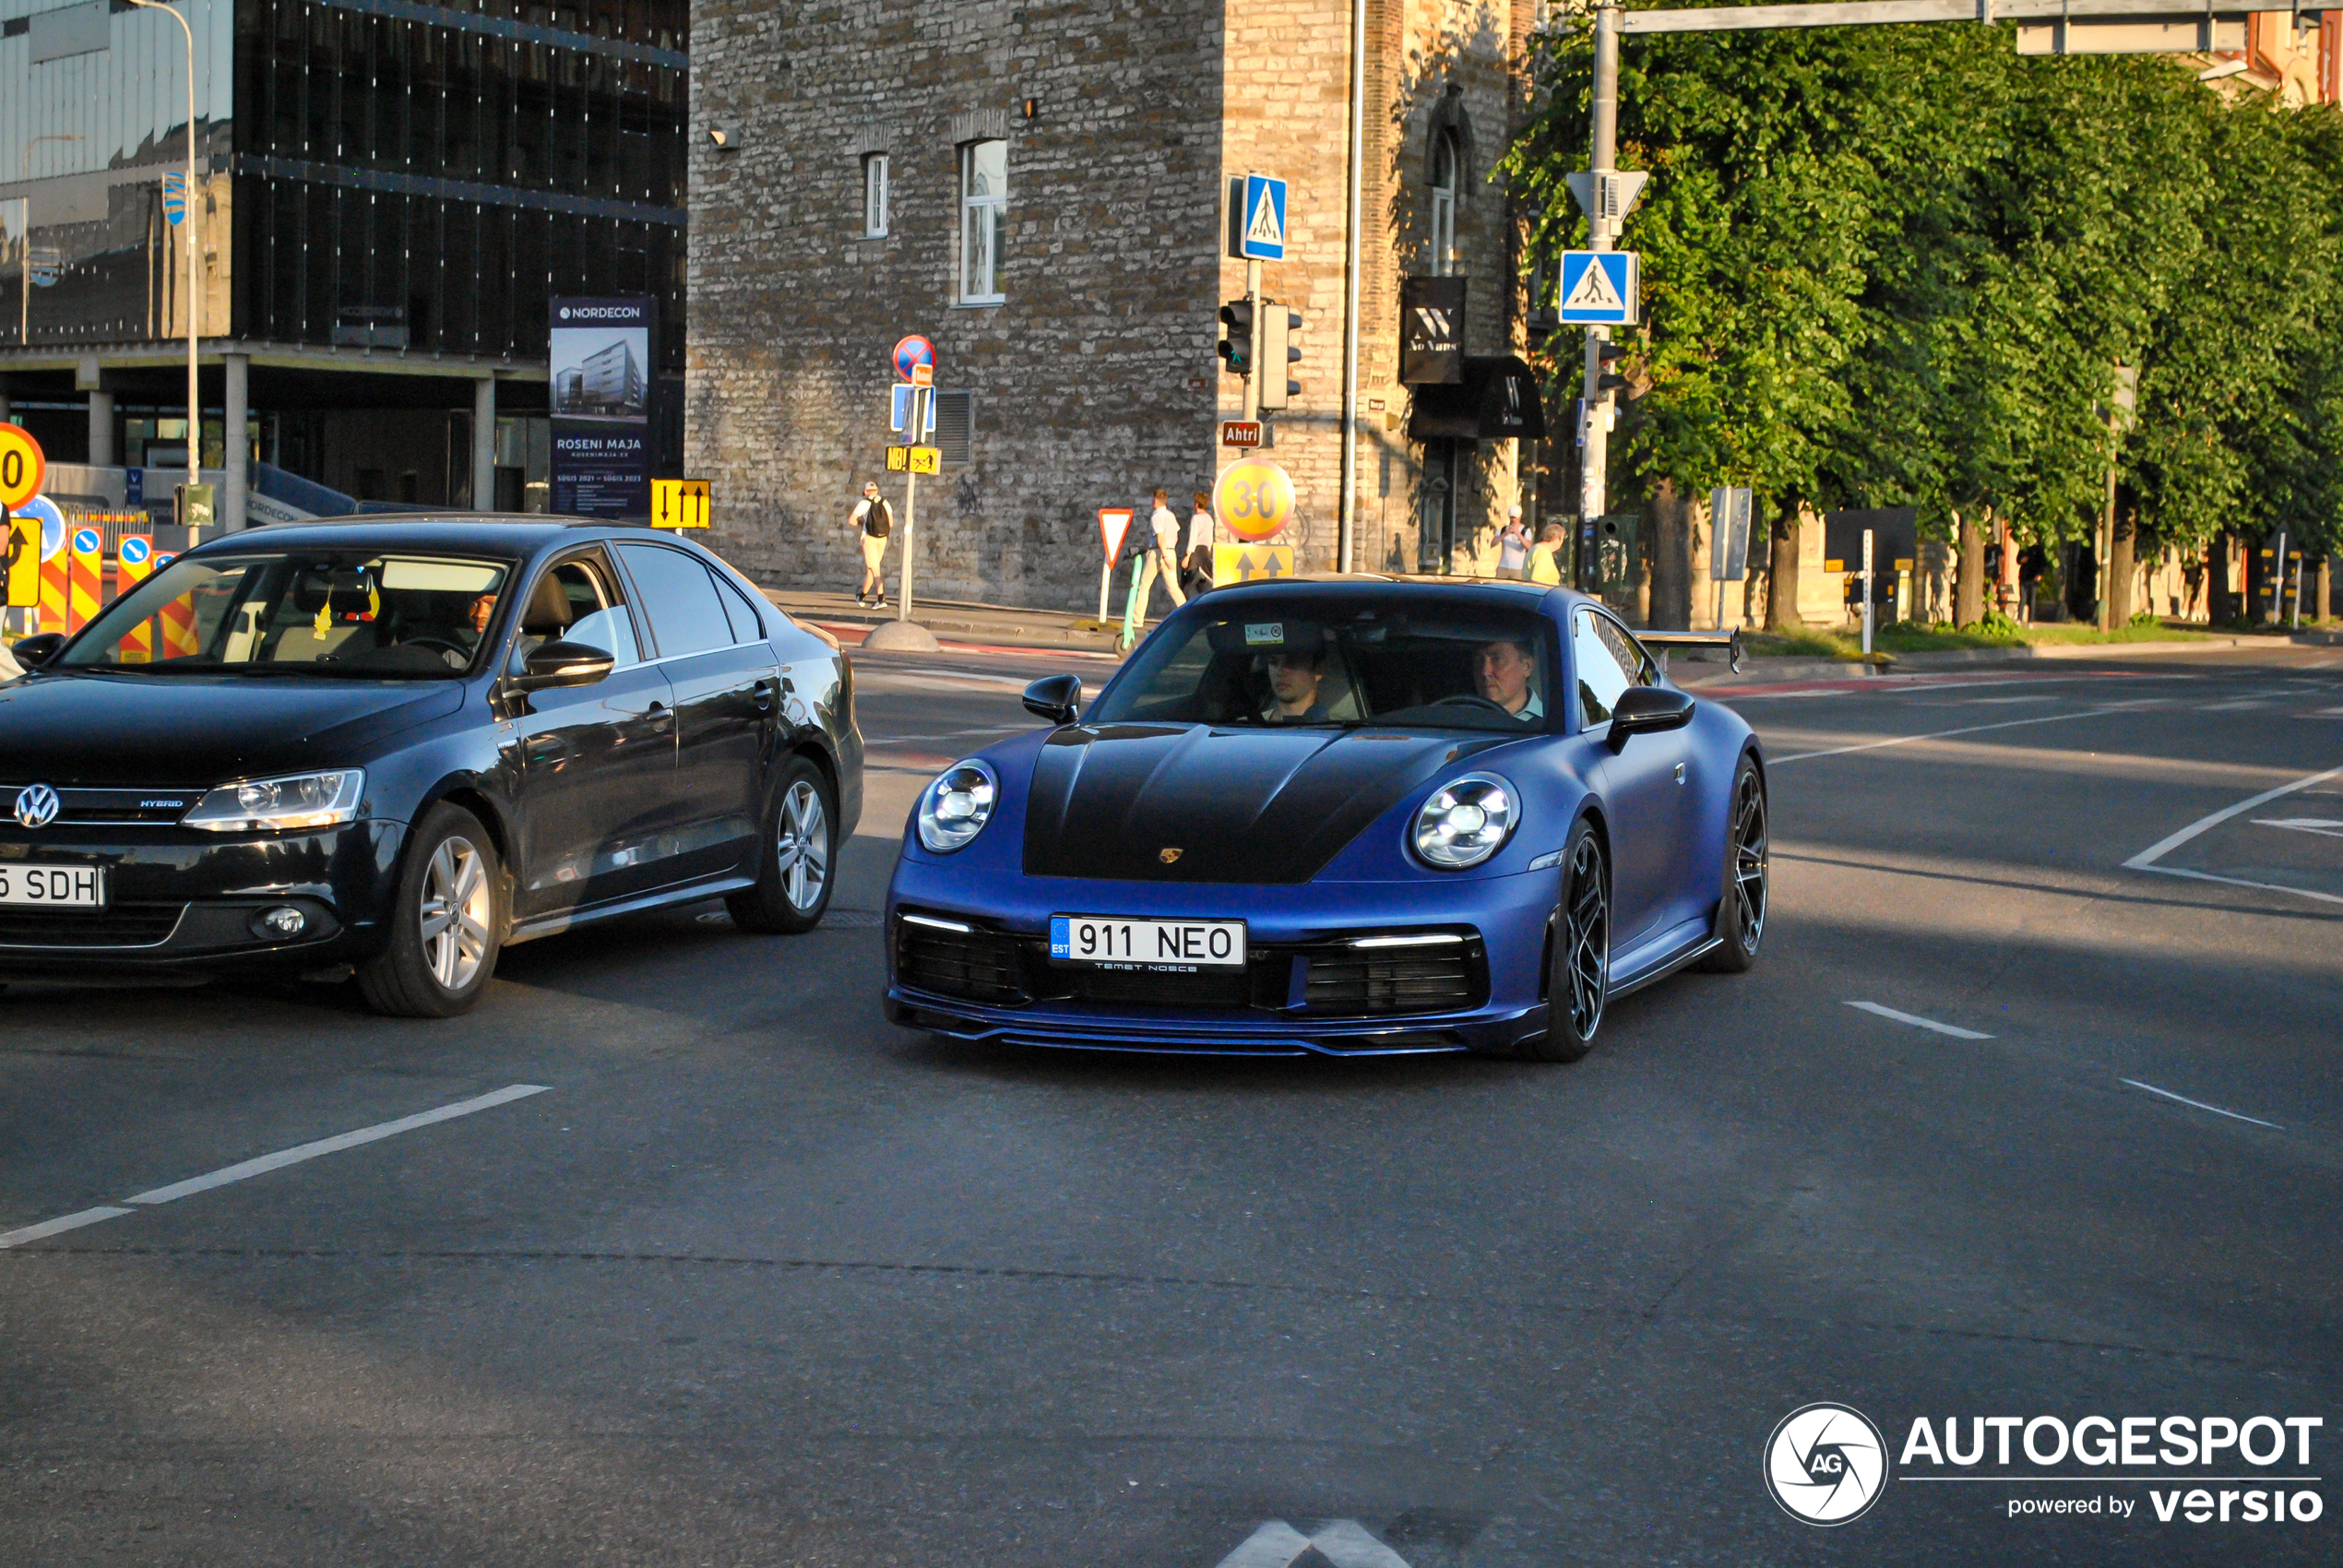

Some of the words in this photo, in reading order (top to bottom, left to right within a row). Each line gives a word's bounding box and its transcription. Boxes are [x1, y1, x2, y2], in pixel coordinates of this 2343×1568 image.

[572, 307, 640, 319] NORDECON
[1226, 427, 1258, 442] Ahtri
[557, 438, 602, 450] ROSENI
[606, 438, 642, 450] MAJA
[886, 446, 908, 471] NB!
[1232, 481, 1277, 519] 30
[140, 800, 184, 808] HYBRID
[26, 870, 95, 901] SDH
[1079, 923, 1132, 957] 911
[1158, 926, 1231, 959] NEO
[1052, 944, 1070, 954] EST
[1095, 962, 1143, 970] TEMET
[1148, 965, 1197, 973] NOSCE
